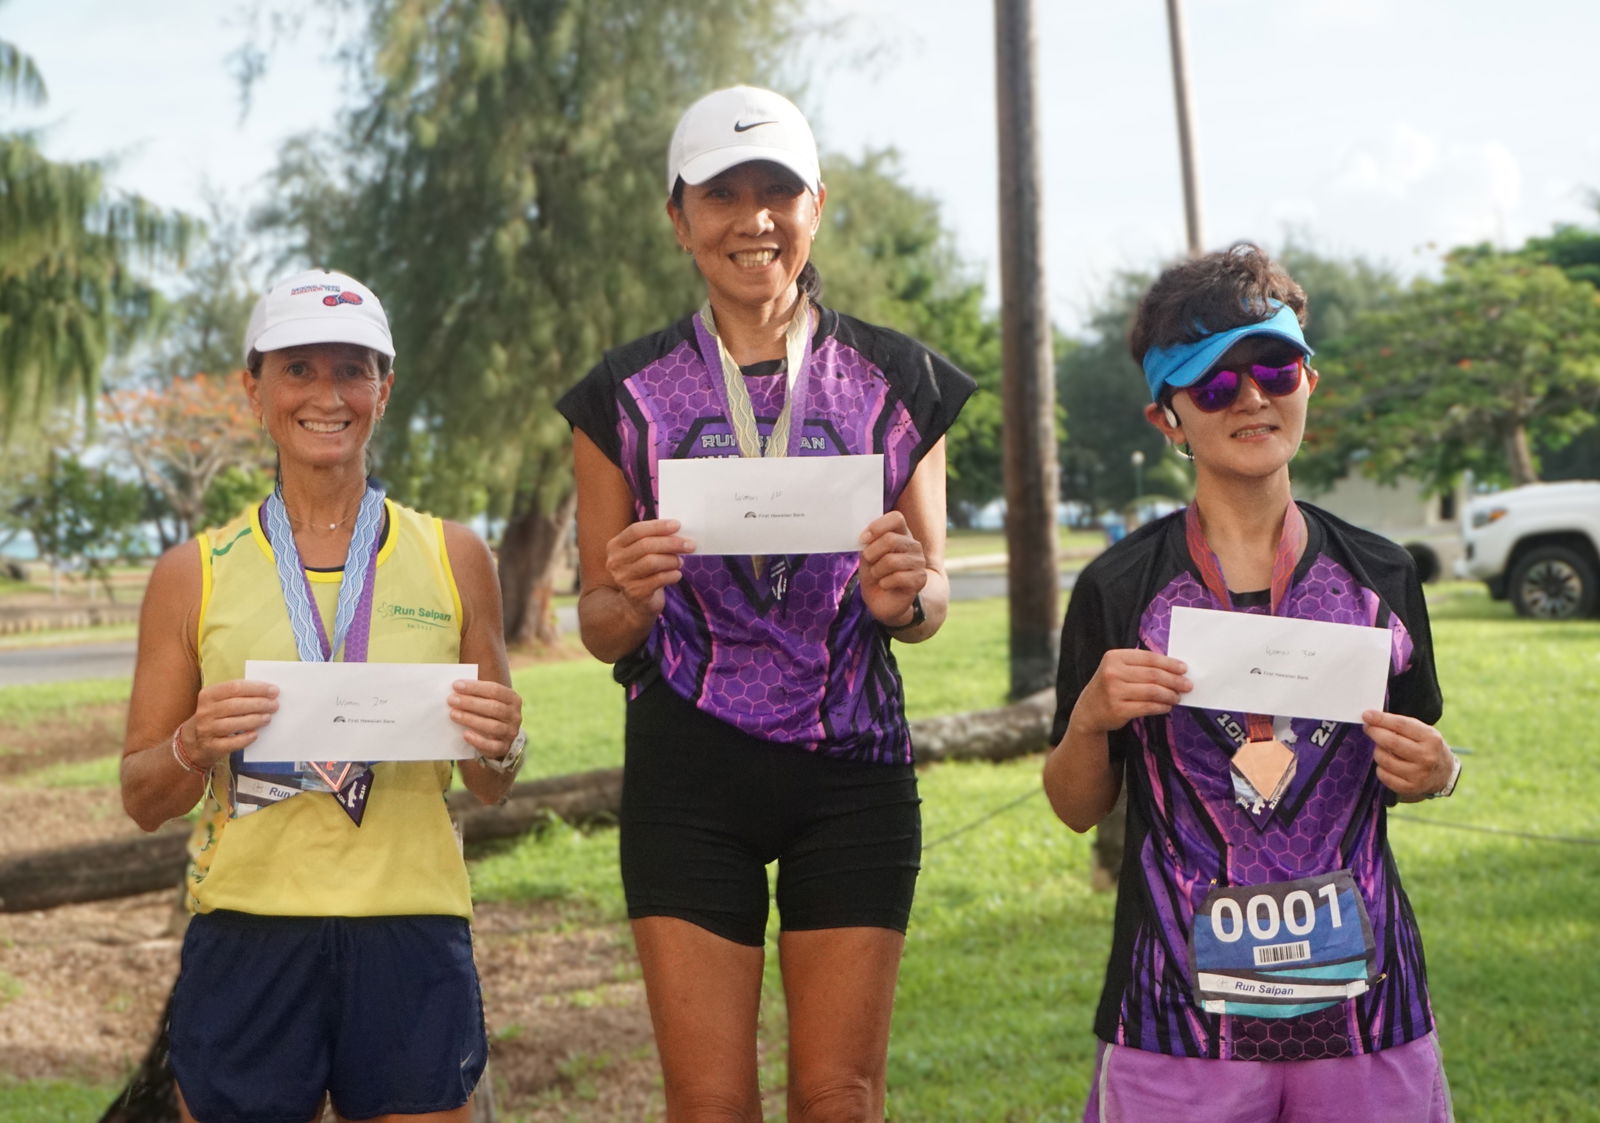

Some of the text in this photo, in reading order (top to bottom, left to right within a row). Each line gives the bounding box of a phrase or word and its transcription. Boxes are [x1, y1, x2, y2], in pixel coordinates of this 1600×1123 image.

[394, 606, 451, 621] Run Saipan
[269, 787, 290, 799] Run
[1211, 883, 1342, 943] 0001
[1235, 981, 1294, 996] Run Saipan
